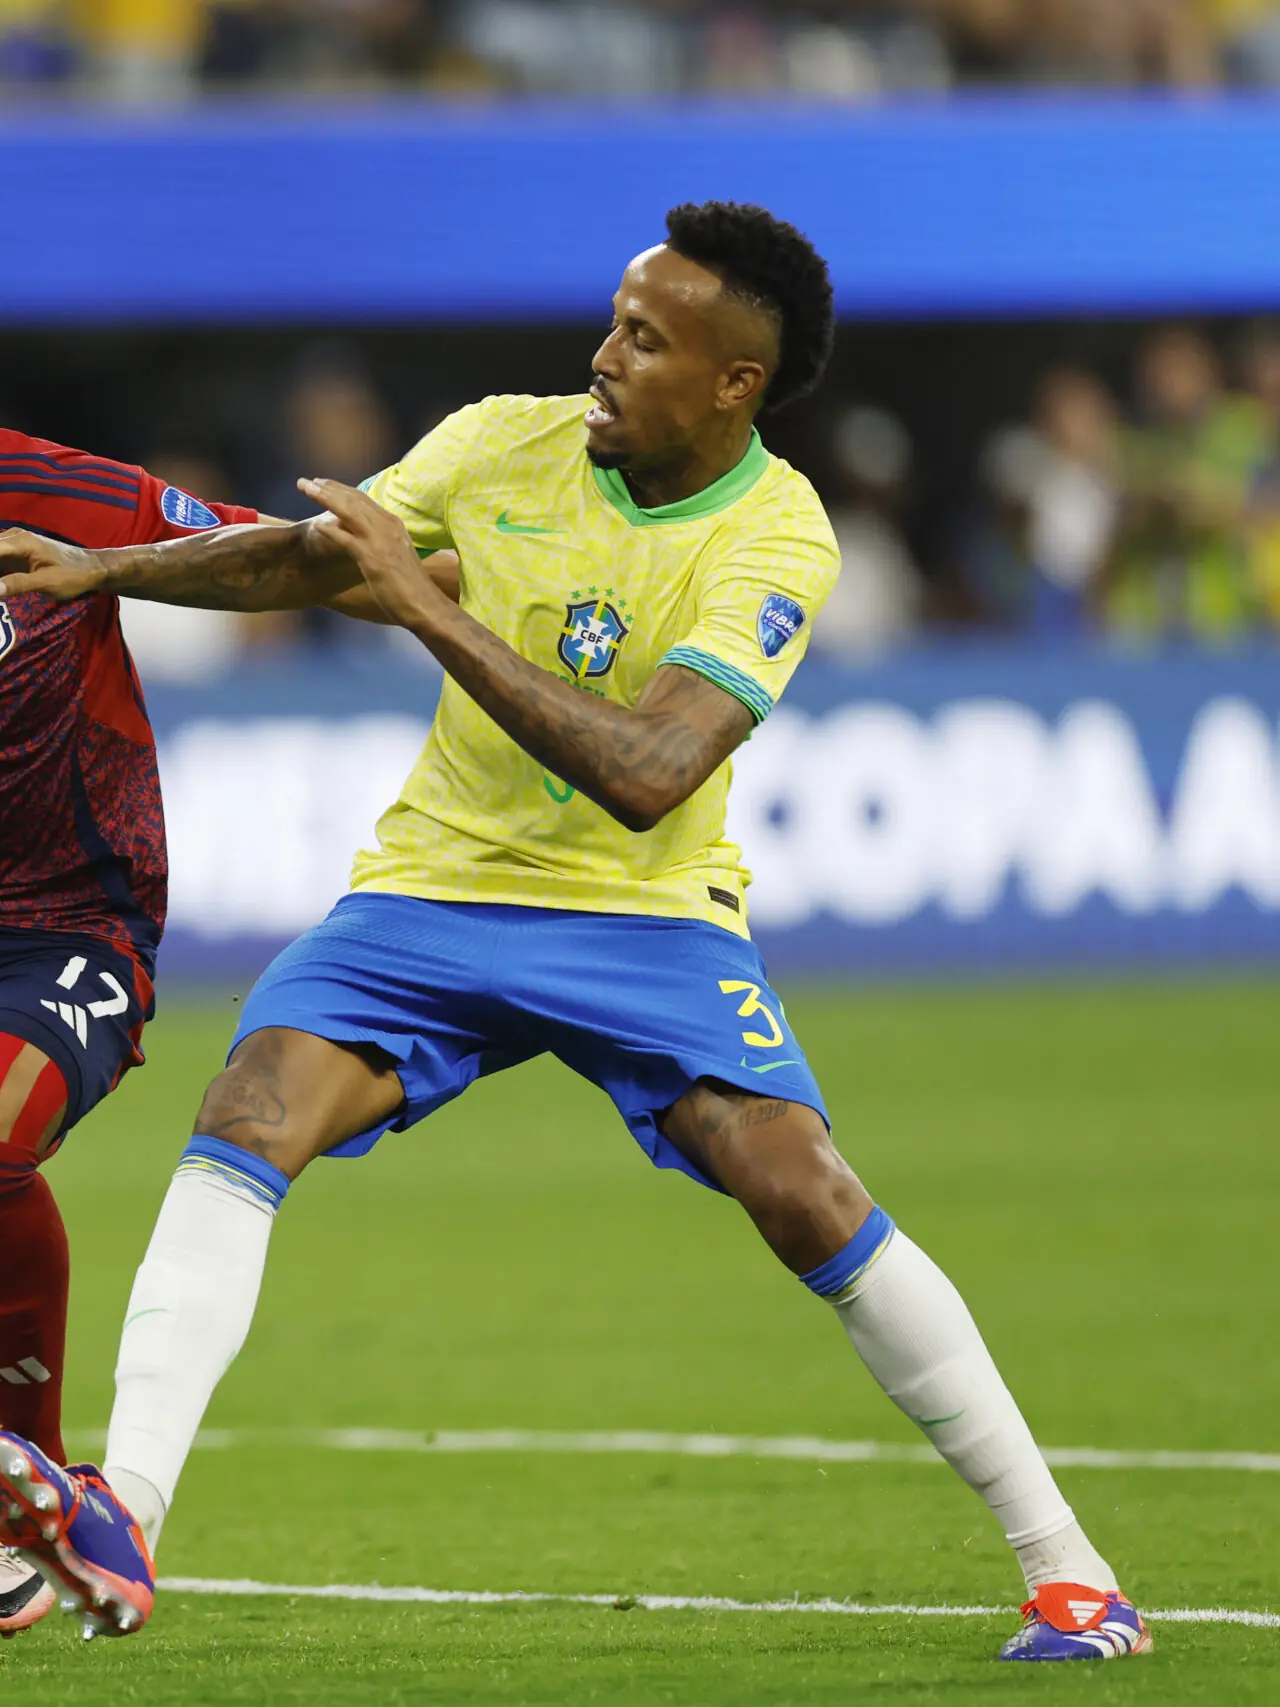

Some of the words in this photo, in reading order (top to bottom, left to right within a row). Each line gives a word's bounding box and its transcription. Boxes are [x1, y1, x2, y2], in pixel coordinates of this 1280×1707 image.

[175, 494, 187, 522] VIBRA
[580, 629, 605, 645] CBF
[718, 980, 784, 1047] 3
